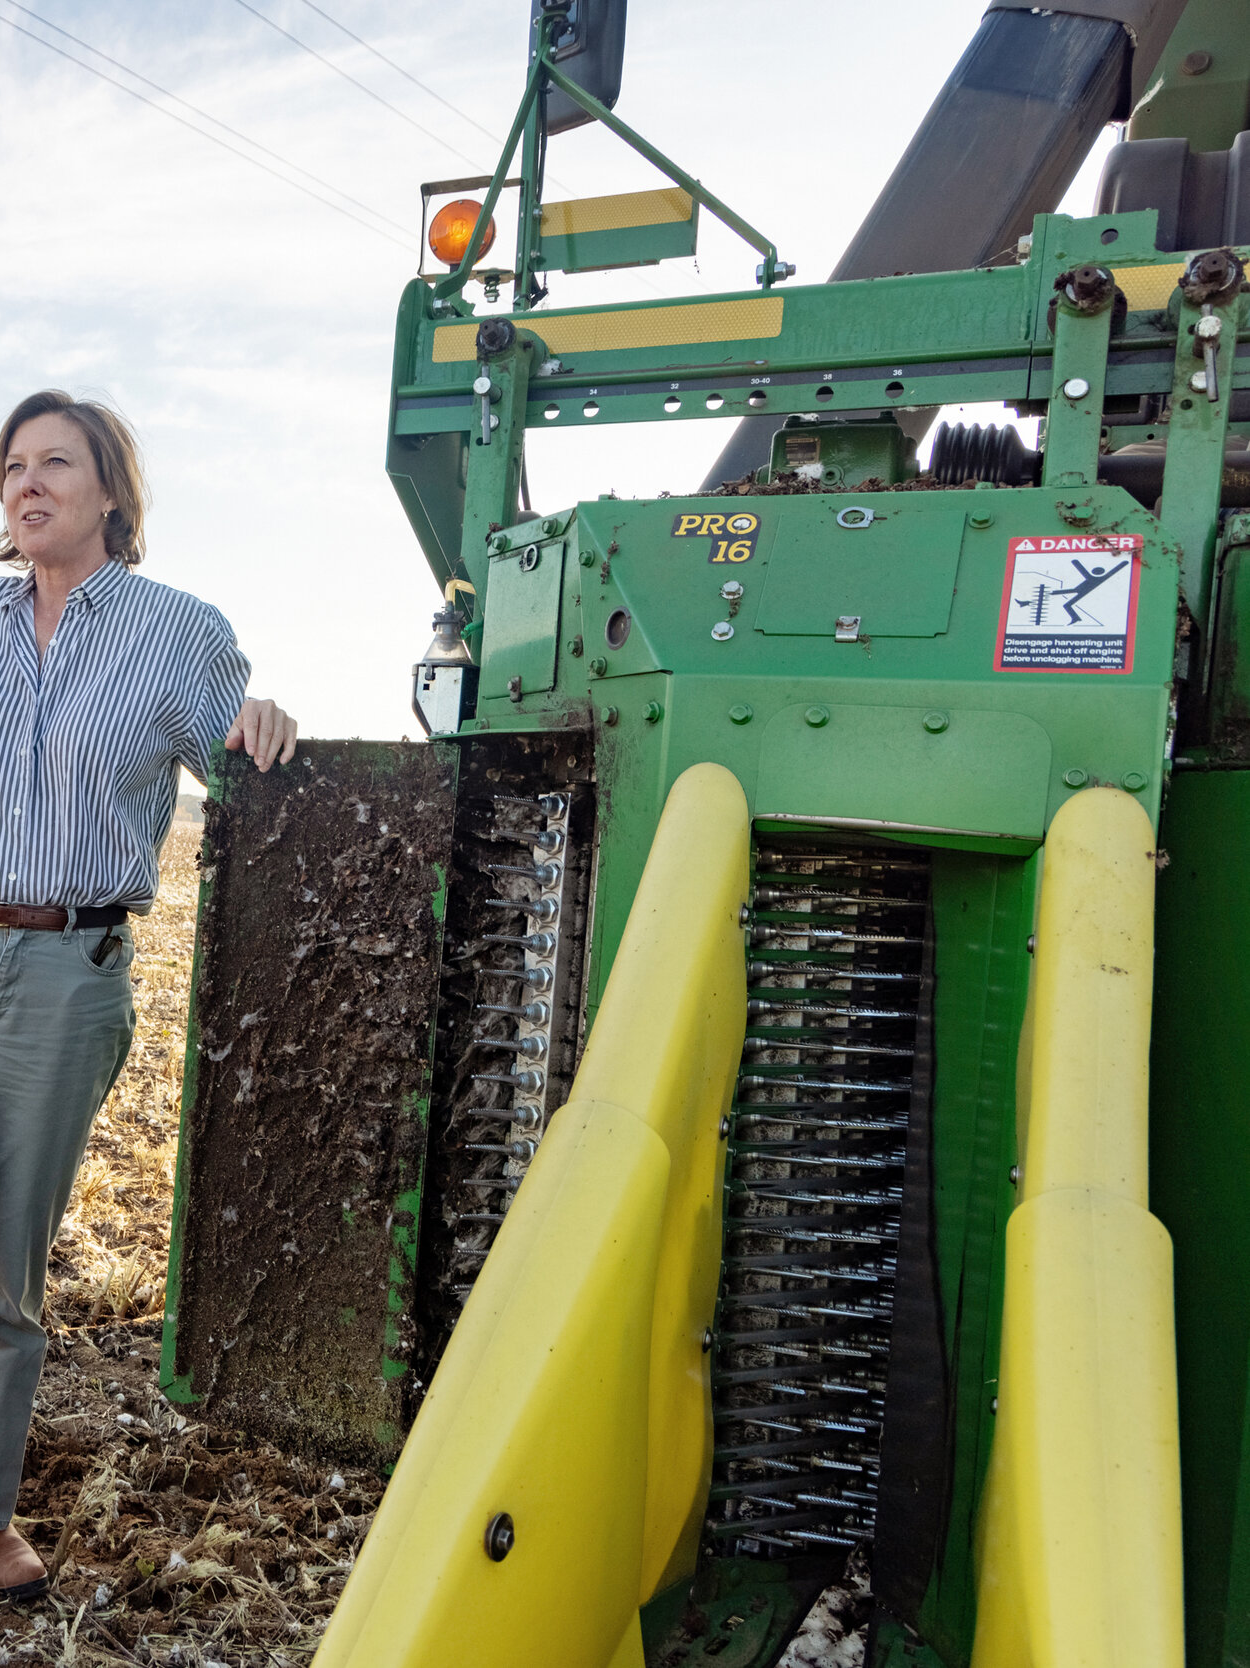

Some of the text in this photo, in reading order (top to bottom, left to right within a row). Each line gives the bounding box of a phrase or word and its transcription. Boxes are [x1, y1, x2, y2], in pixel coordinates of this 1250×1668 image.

[674, 513, 758, 536] PRO
[1041, 537, 1134, 551] DANGER
[712, 540, 752, 562] 16
[1005, 638, 1123, 648] Disengage harvesting unit
[1003, 646, 1028, 654] drive
[1050, 647, 1072, 655] shut
[1073, 647, 1088, 655] off
[1088, 648, 1123, 656] engine
[1031, 655, 1081, 664] unclogging
[1081, 656, 1123, 664] machine.
